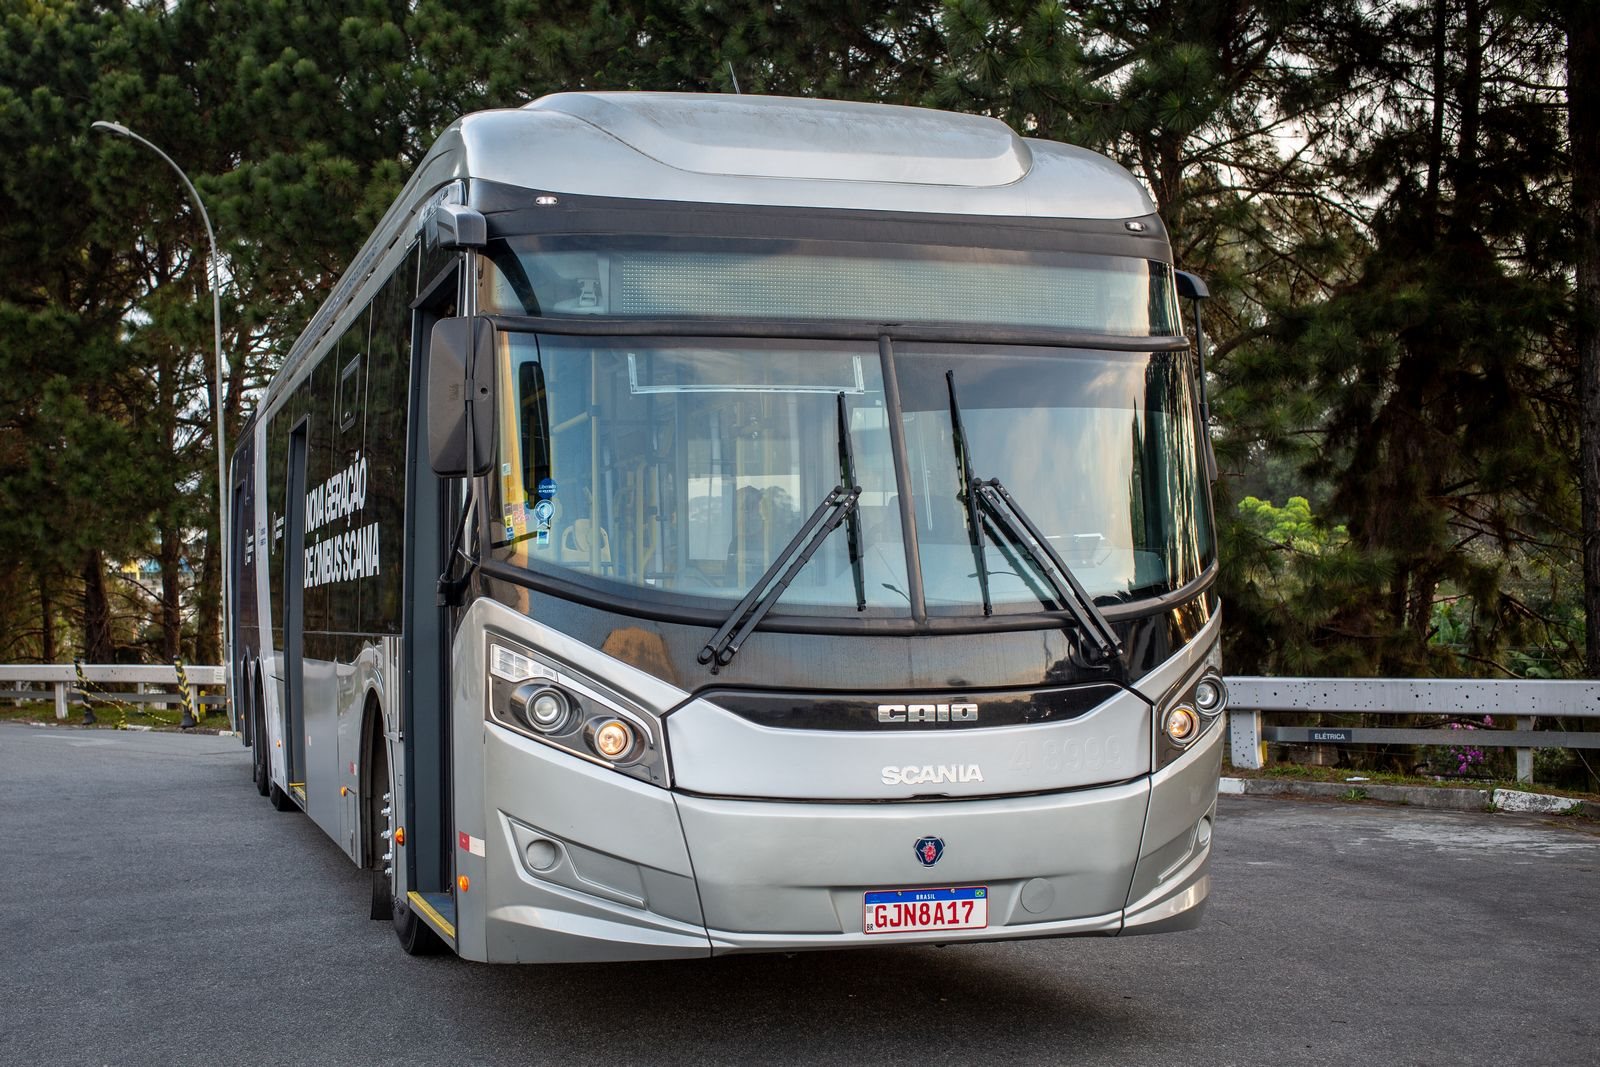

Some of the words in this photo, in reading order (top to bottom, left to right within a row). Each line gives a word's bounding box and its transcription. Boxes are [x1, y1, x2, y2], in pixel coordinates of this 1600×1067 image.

[305, 483, 324, 533] NOVA
[325, 450, 367, 527] GERAÇÃO
[303, 546, 314, 588] DE
[313, 533, 342, 587] ÔNIBUS
[343, 521, 380, 581] SCANIA
[877, 703, 979, 723] CAIO
[1314, 732, 1345, 740] ELÉTRICA
[881, 763, 985, 786] SCANIA
[875, 901, 974, 928] GJN8A17
[866, 923, 874, 931] BR
